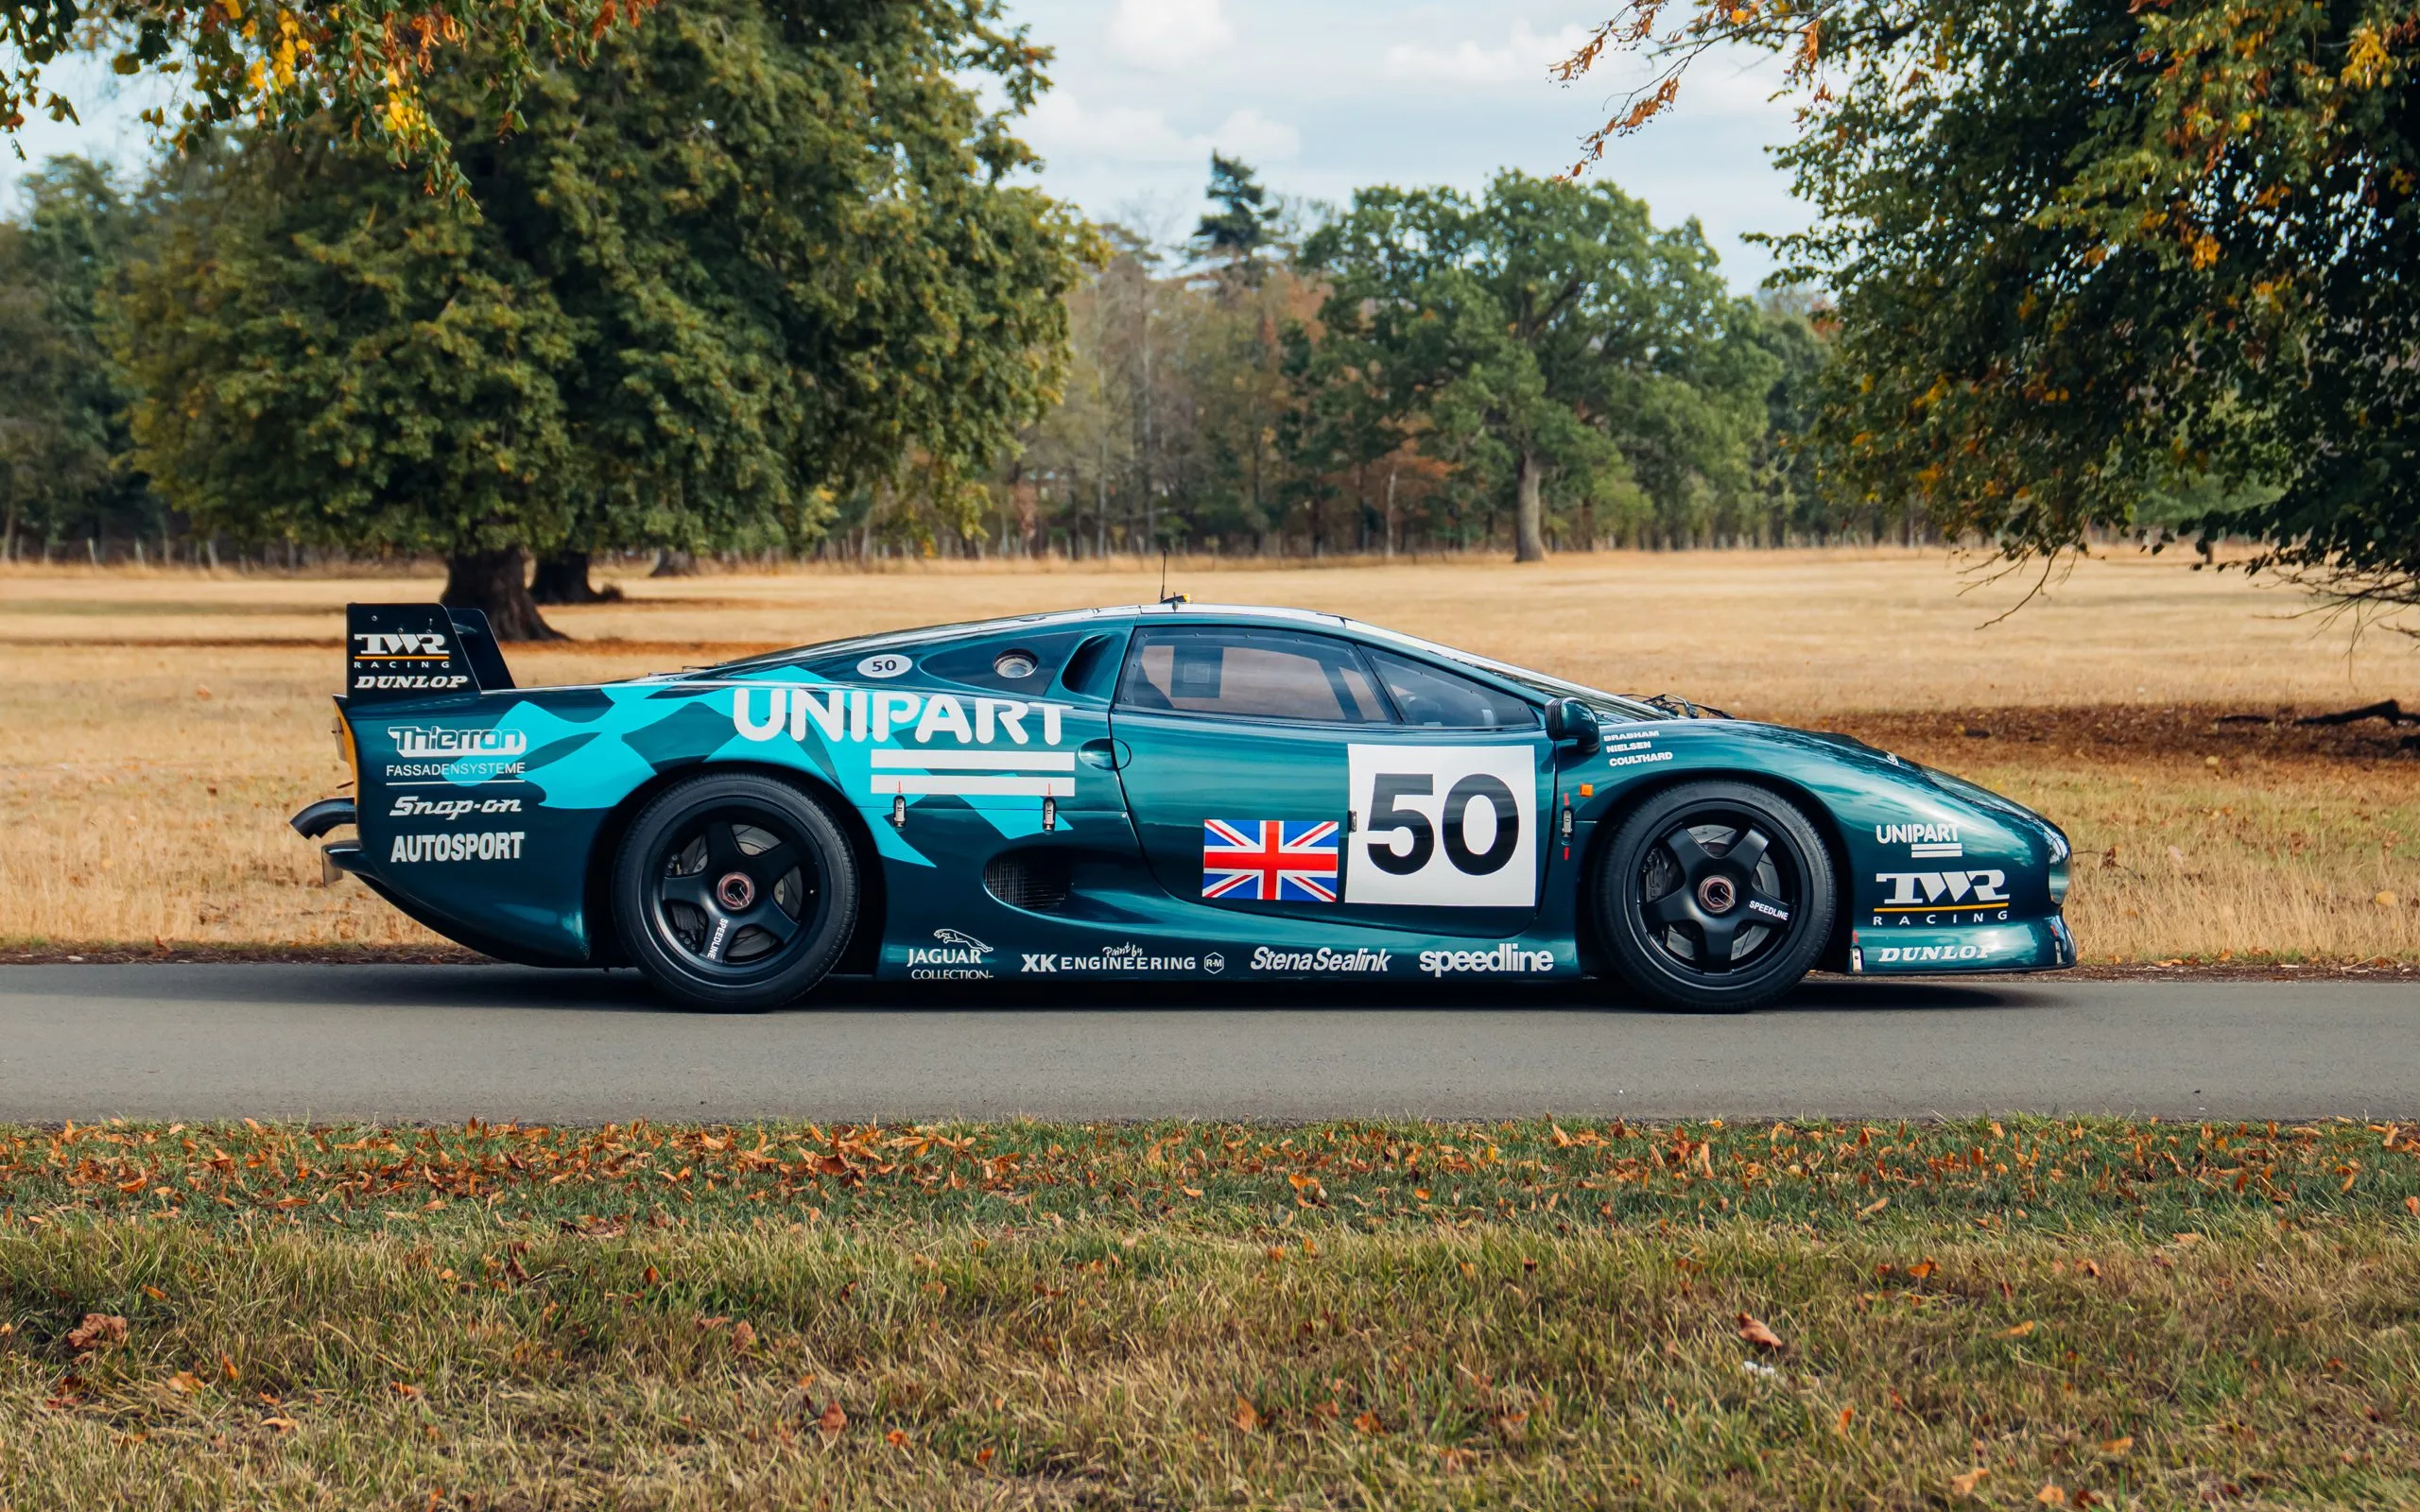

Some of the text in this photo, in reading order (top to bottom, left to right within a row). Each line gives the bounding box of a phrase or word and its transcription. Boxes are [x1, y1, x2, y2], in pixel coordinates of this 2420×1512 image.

[354, 633, 450, 655] TWR
[354, 661, 451, 669] RACING
[871, 659, 898, 673] 50
[354, 675, 468, 689] DUNLOP
[733, 687, 1075, 746] UNIPART
[388, 726, 527, 757] Thierron
[1603, 730, 1660, 742] BRABHAM
[1606, 740, 1651, 753] NIELSEN
[1609, 751, 1673, 767] COULTHARD
[386, 763, 526, 777] FASSADENSYSTEME
[389, 796, 522, 820] Snap-on
[1367, 773, 1519, 876] 50
[1876, 823, 1960, 844] UNIPART
[390, 832, 526, 863] AUTOSPORT
[1876, 869, 2010, 904] TWR
[1749, 900, 1789, 921] SPEEDLINE
[1873, 910, 2008, 926] RACING
[706, 918, 729, 960] SPEEDLINE
[907, 948, 982, 967] JAGUAR
[1102, 941, 1143, 957] Paint by
[1020, 954, 1196, 972] XK ENGINEERING
[1205, 958, 1222, 968] R-M
[1419, 943, 1554, 977] speedline
